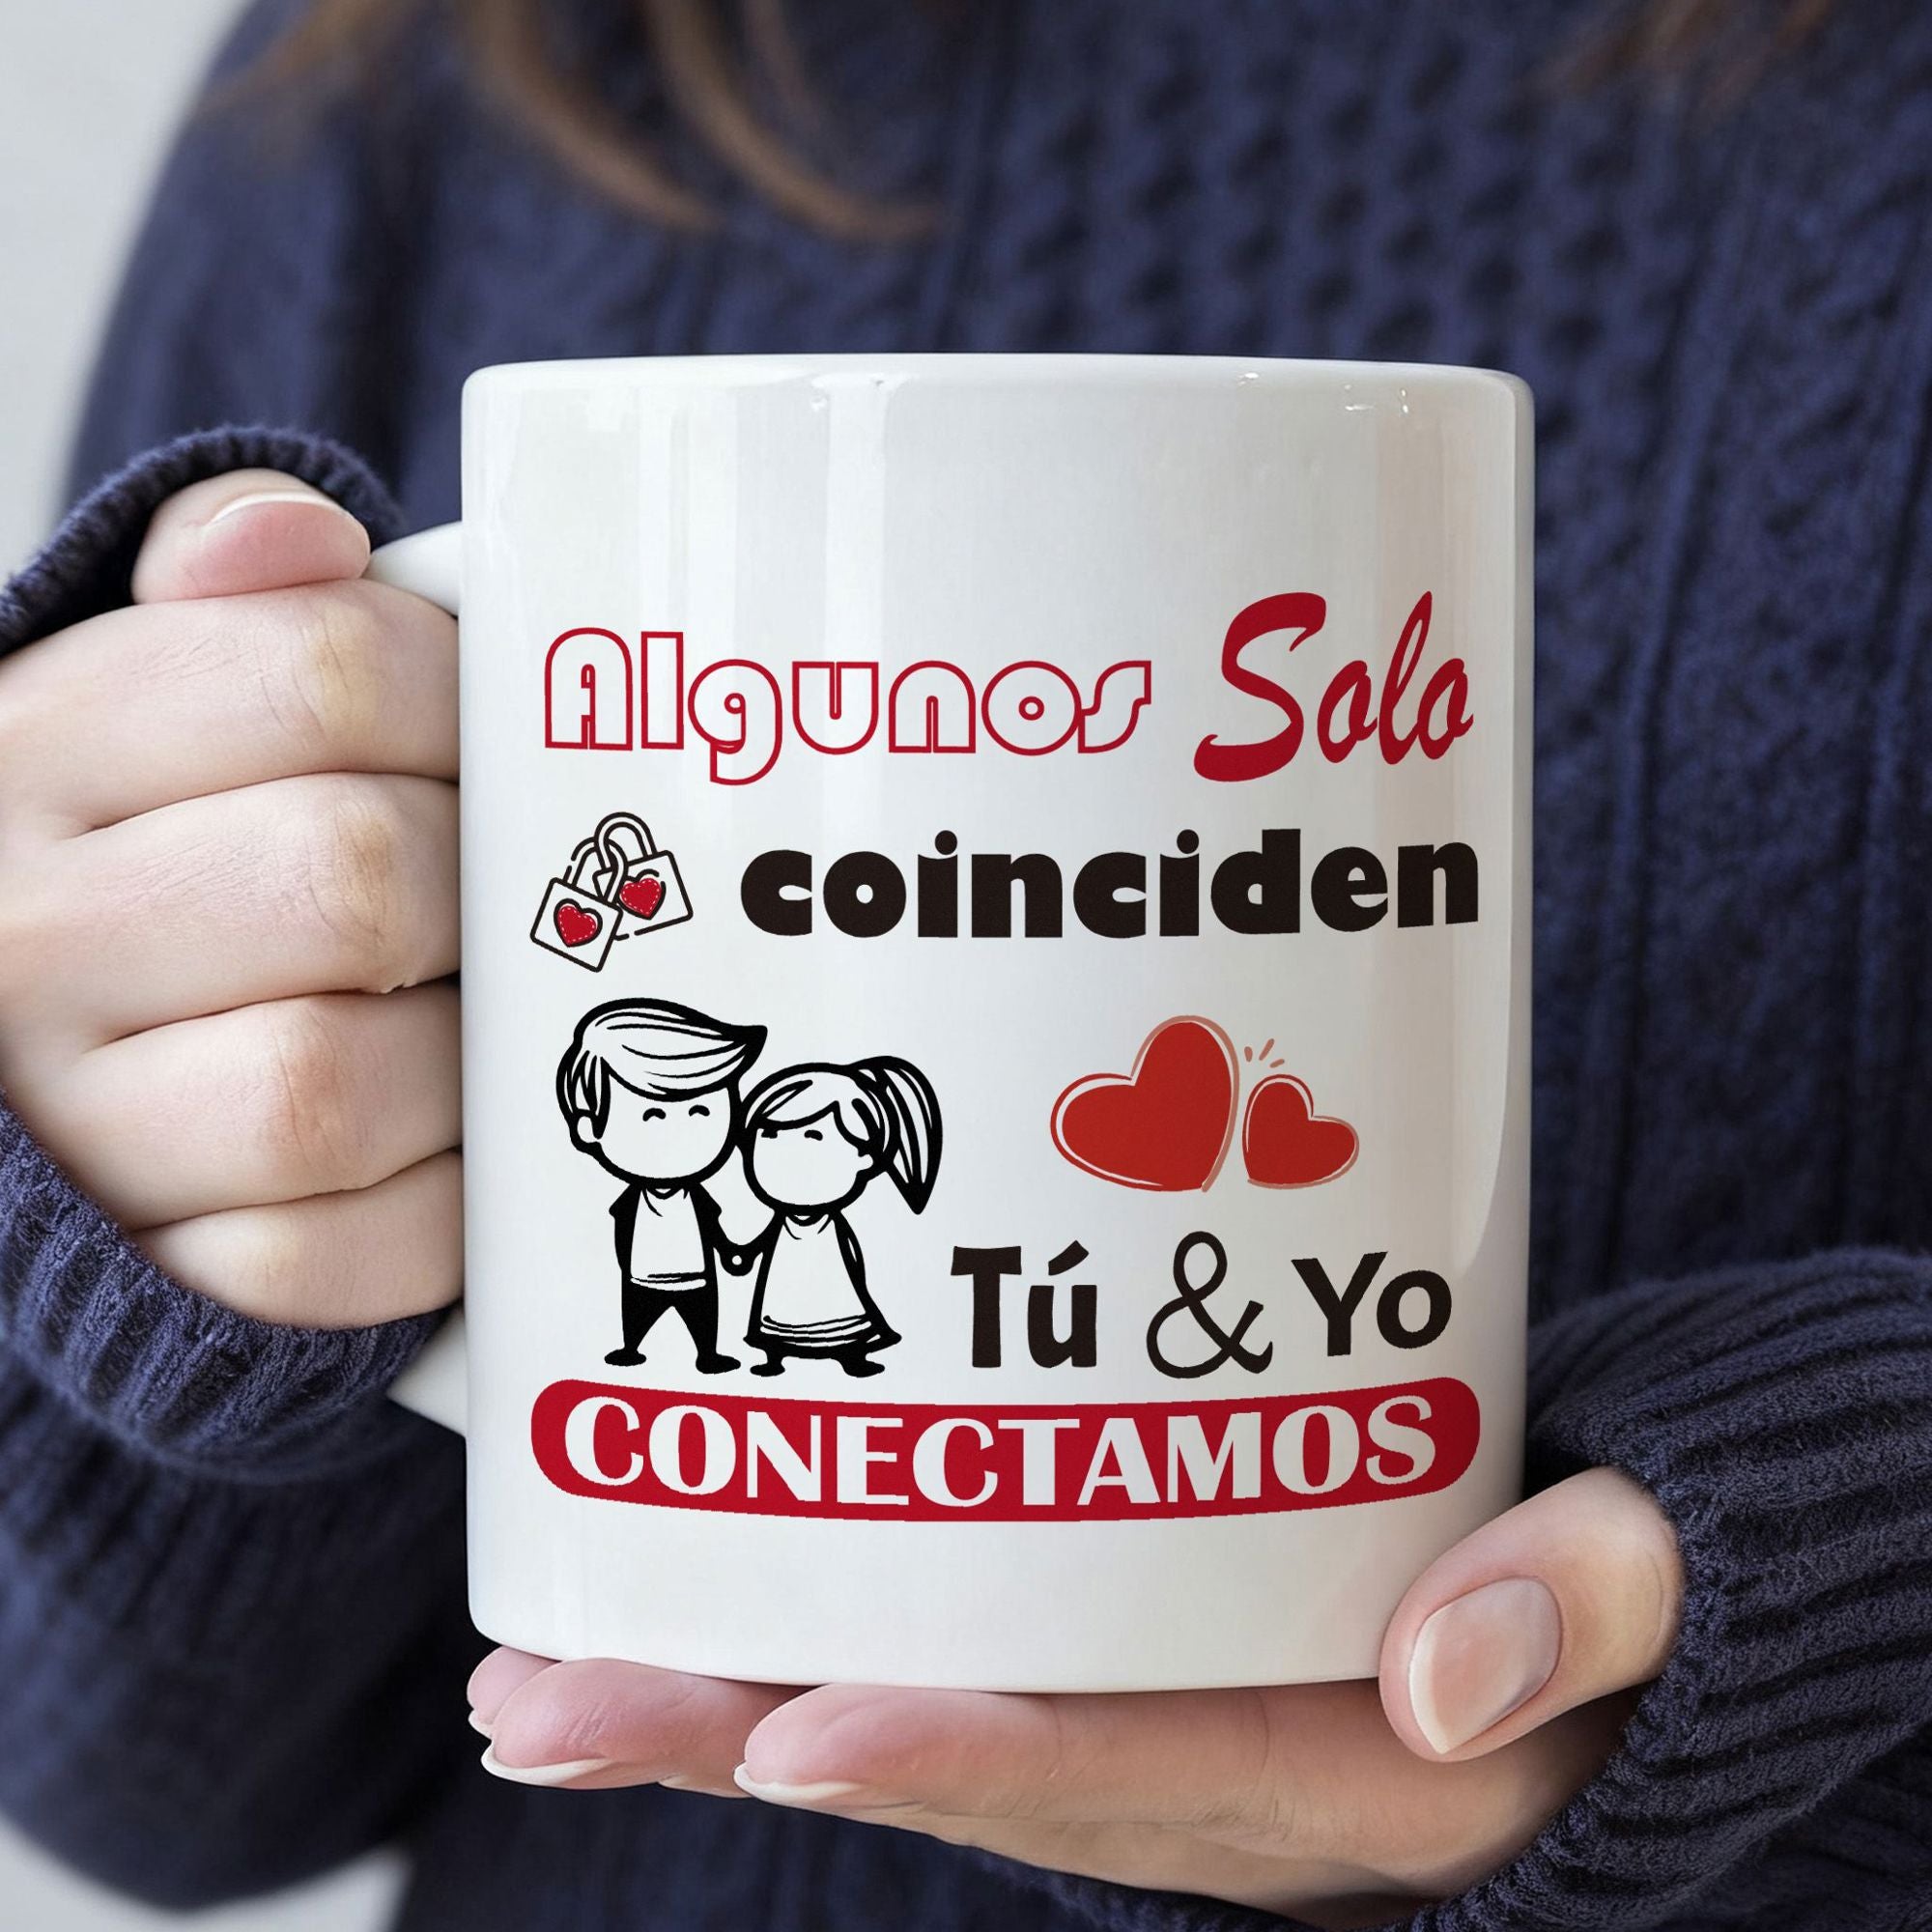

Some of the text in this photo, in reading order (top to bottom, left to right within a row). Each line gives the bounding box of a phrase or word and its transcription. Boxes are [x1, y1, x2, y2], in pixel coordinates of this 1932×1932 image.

[545, 591, 1473, 785] Algunos Solo
[741, 829, 1478, 938] coinciden
[951, 1231, 1452, 1378] Tú & Yo
[565, 1397, 1435, 1507] CONECTAMOS
